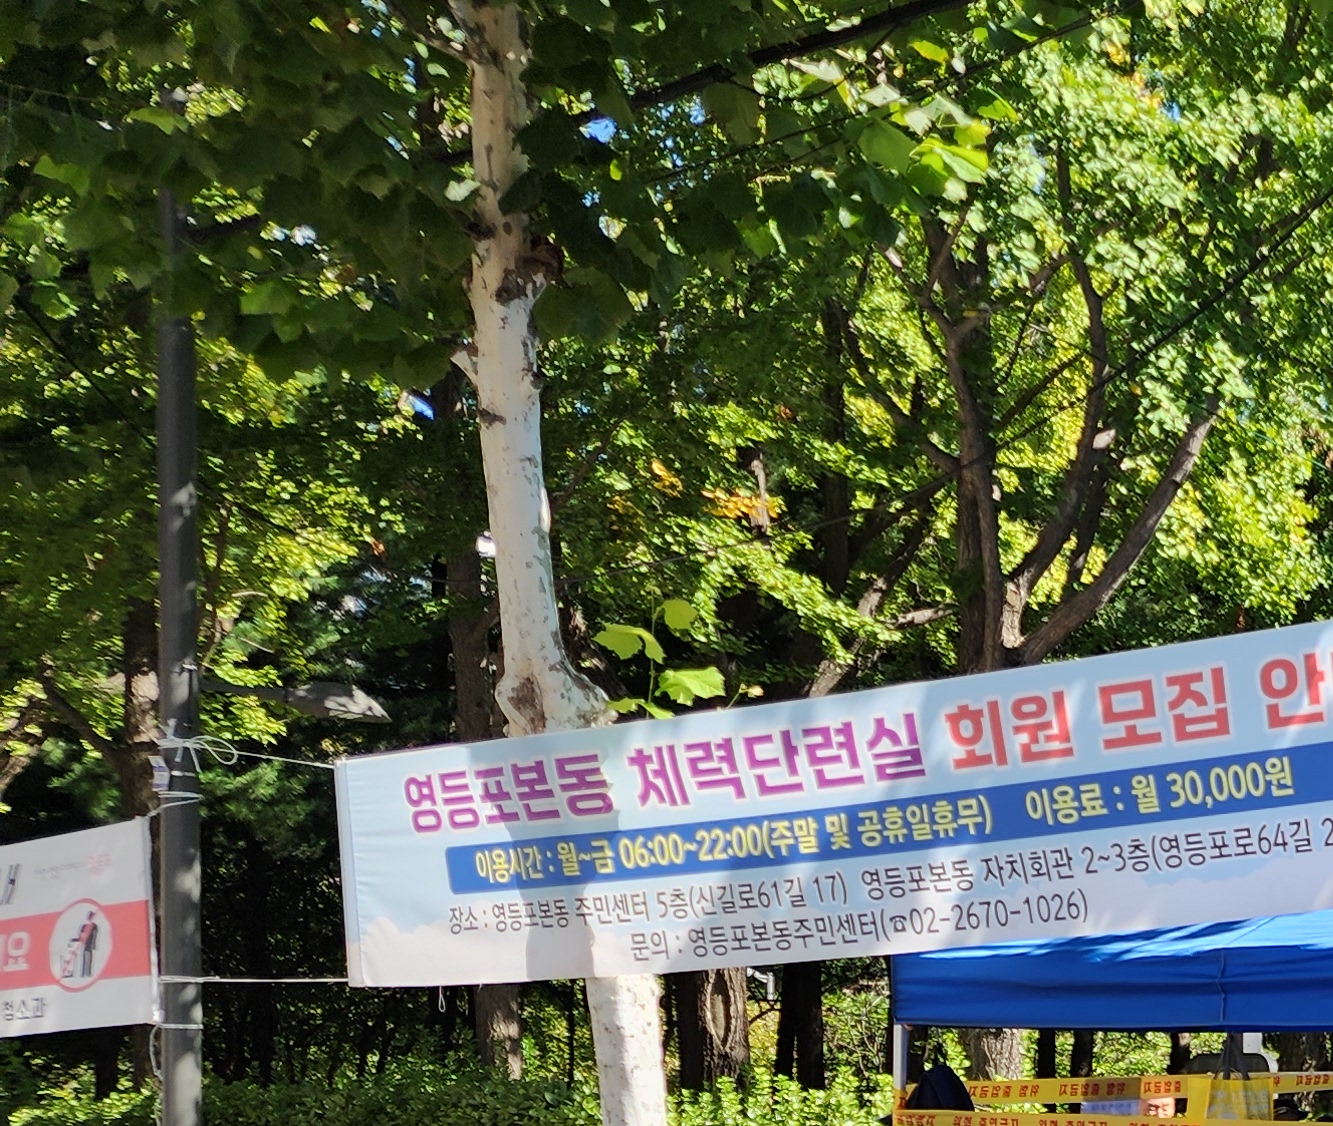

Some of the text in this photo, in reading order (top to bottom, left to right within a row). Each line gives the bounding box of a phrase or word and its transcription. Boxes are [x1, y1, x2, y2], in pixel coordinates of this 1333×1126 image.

[404, 753, 614, 834] 영등포본동
[627, 712, 927, 807] 체력단련실
[945, 691, 1075, 770] 회원
[1098, 666, 1231, 751] 모집
[449, 905, 478, 935] 장소
[492, 899, 569, 932] 영등포본동
[575, 890, 649, 928] 주민센터
[812, 870, 848, 905] 17)
[861, 858, 974, 900] 영등포본동
[984, 845, 1074, 888] 자치회관
[1083, 818, 1312, 875] 2~3층(영등포로64길
[476, 846, 544, 884] 이용시간
[557, 840, 615, 877] 월~금
[825, 814, 851, 849] 및
[857, 794, 993, 848] 공휴일휴무)
[1025, 783, 1108, 827] 이용료
[1131, 774, 1161, 814] 월
[1166, 756, 1295, 809] 30,000원
[631, 929, 670, 962] 문의
